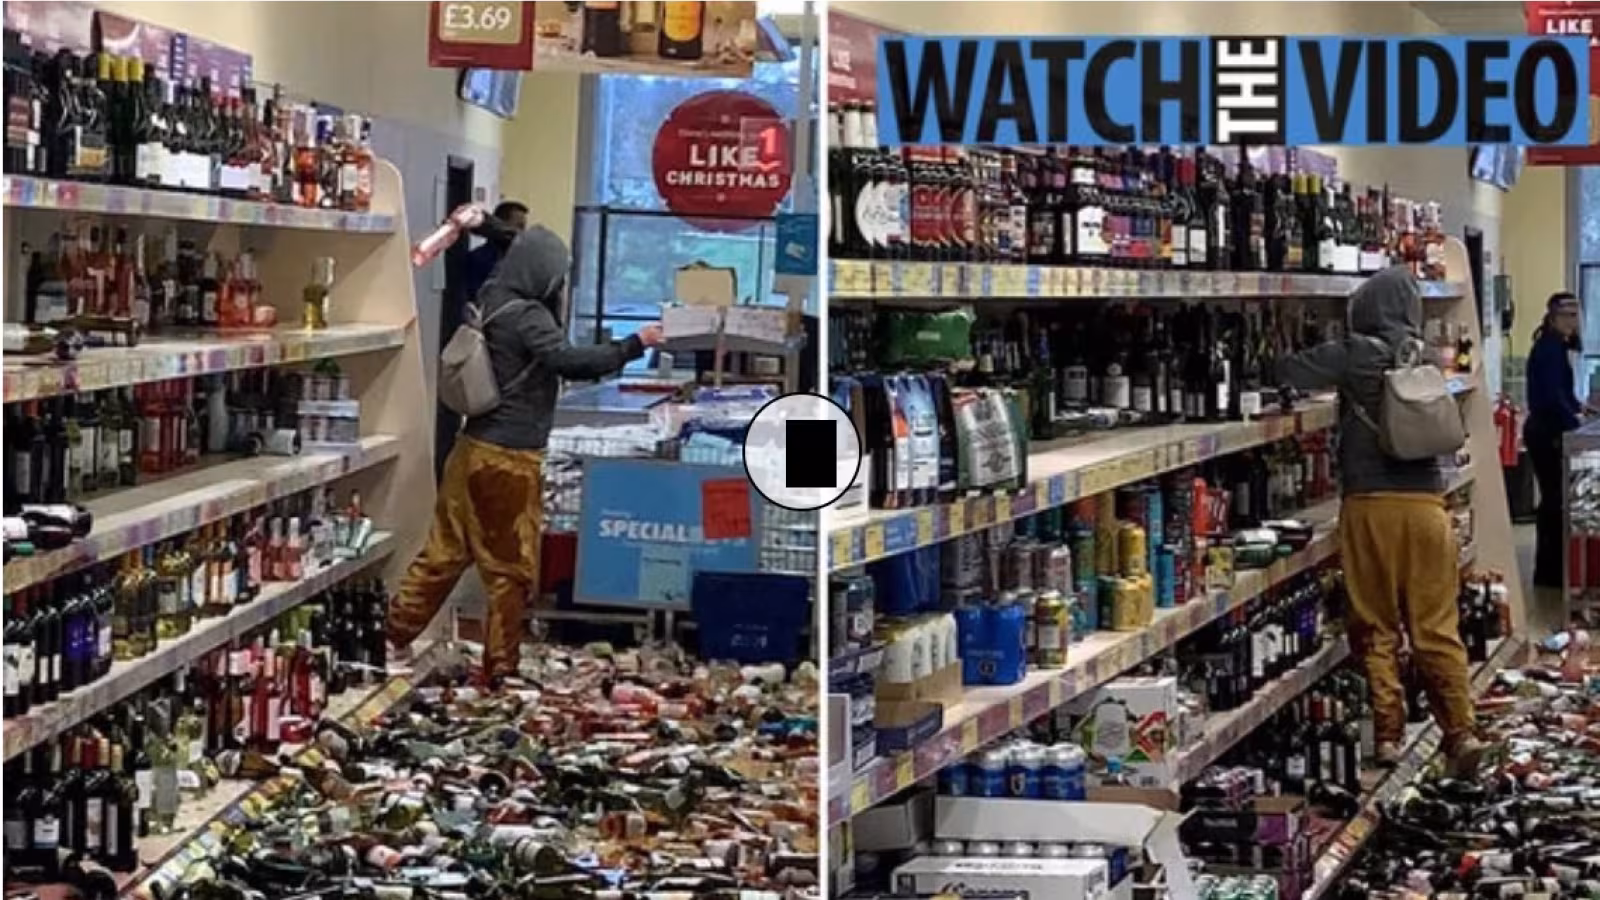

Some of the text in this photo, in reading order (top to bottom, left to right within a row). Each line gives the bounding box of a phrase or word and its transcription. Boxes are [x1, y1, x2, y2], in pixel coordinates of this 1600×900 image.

[445, 4, 511, 30] £3.69
[1546, 18, 1593, 34] LIKE
[689, 143, 760, 168] LIKE
[664, 170, 781, 189] CHRISTMAS
[598, 519, 688, 542] SPECIAL
